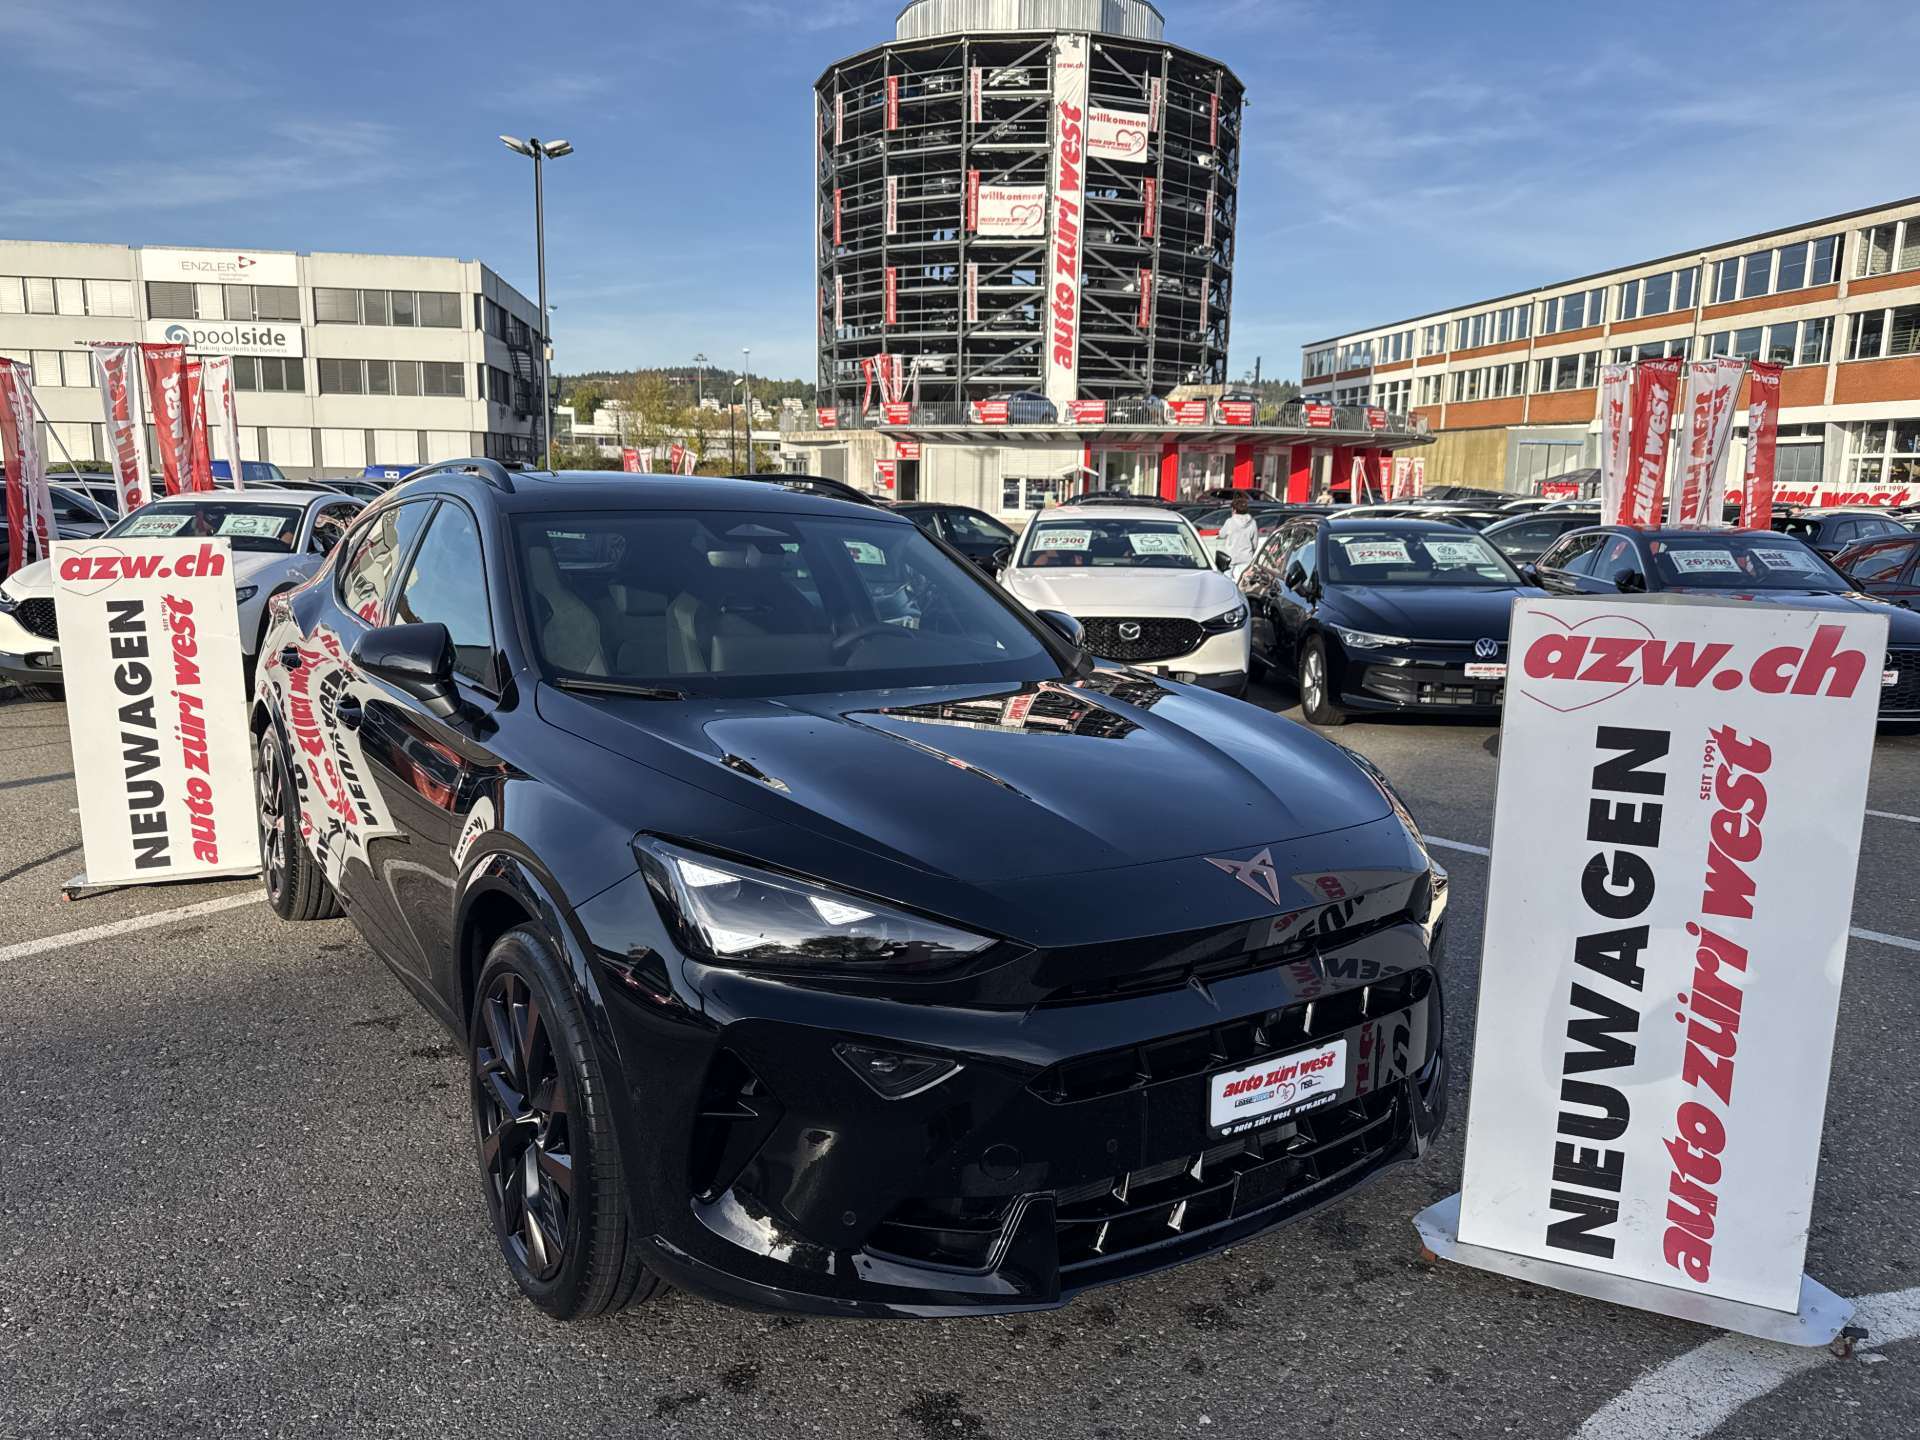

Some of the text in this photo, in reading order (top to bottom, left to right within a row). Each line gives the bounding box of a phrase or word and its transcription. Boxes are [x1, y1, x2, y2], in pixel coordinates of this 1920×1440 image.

[1088, 112, 1147, 127] willkommen
[980, 191, 1043, 200] willkommen
[1053, 101, 1082, 370] auto züri west
[181, 260, 236, 272] ENZLER
[193, 326, 286, 350] poolside
[1632, 383, 1670, 525] züri west
[60, 543, 225, 581] azw.ch
[1043, 536, 1086, 545] 25'300
[1359, 550, 1404, 558] 22'900
[1523, 625, 1866, 699] azw.ch
[106, 600, 172, 870] NEUWAGEN
[161, 593, 218, 865] auto züri west
[1699, 738, 1717, 801] SEIT 1991
[1545, 726, 1672, 1260] NEUWAGEN
[1661, 723, 1773, 1285] auto züri west
[1223, 1053, 1336, 1098] auto züri west
[1233, 1121, 1252, 1134] auto
[1254, 1115, 1272, 1128] züri
[1273, 1109, 1291, 1121] west
